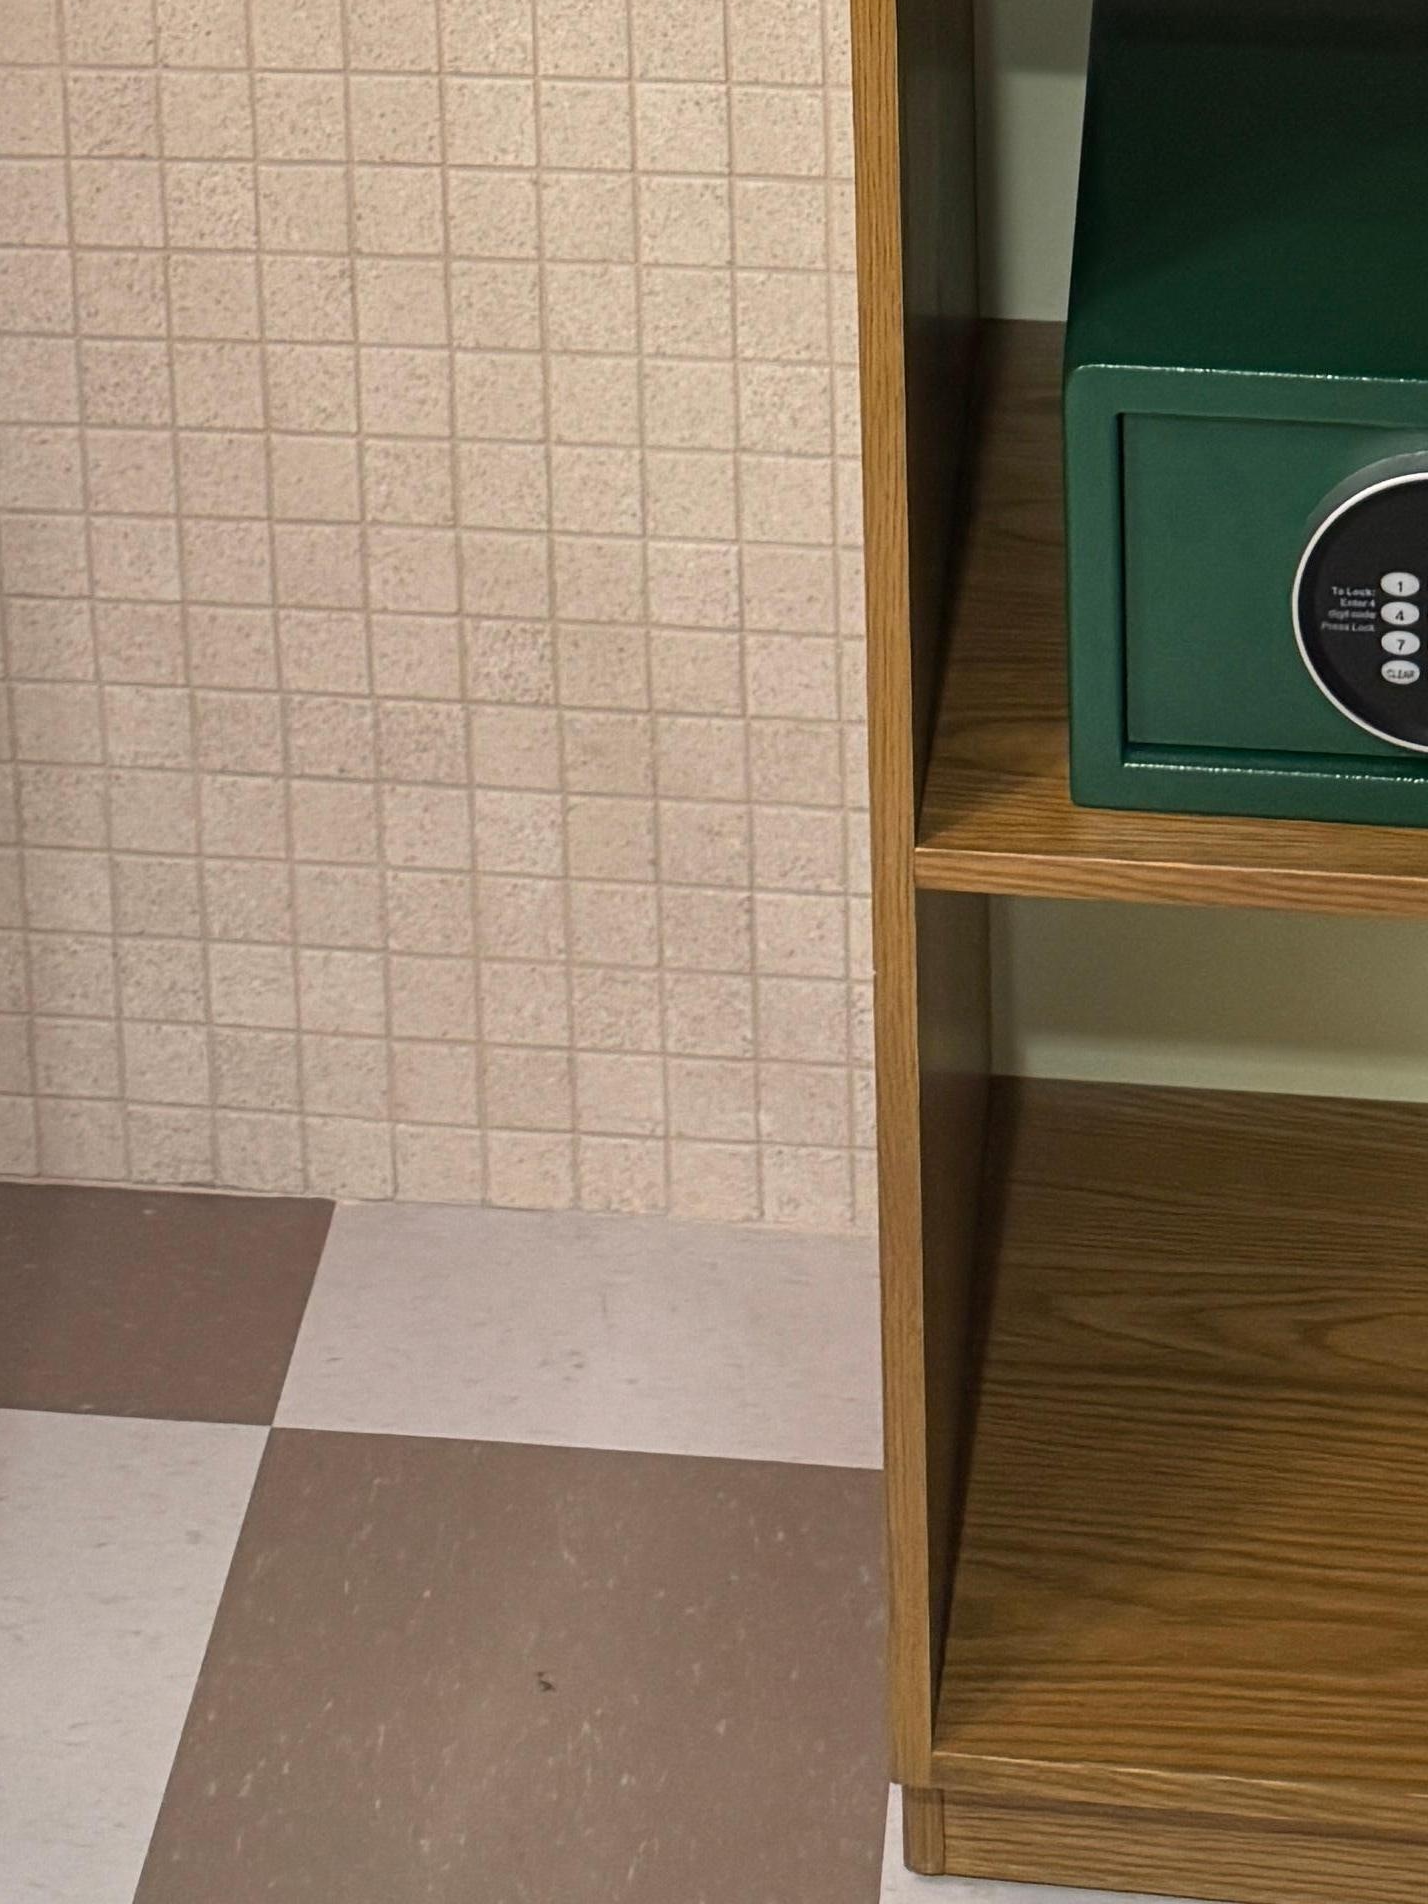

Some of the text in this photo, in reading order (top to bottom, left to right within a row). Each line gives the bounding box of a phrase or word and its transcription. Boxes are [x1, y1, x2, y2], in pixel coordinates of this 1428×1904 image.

[1398, 581, 1403, 593] 1
[1395, 610, 1404, 621] 4
[1397, 639, 1405, 651] 7
